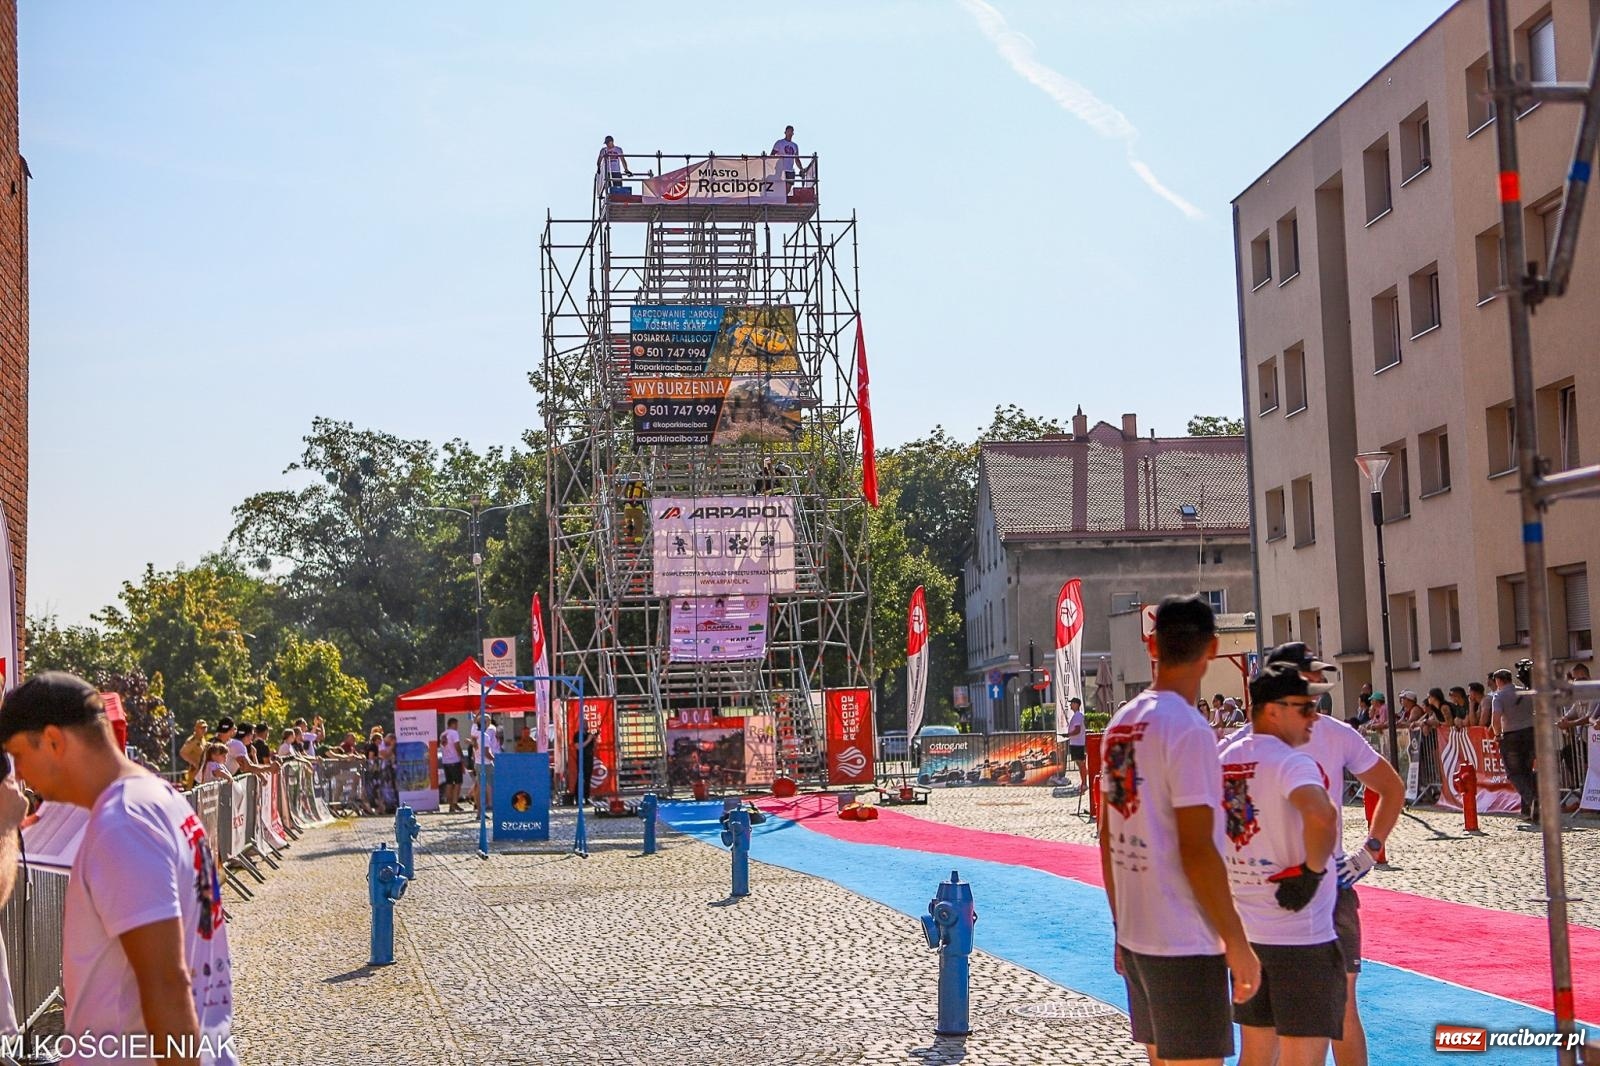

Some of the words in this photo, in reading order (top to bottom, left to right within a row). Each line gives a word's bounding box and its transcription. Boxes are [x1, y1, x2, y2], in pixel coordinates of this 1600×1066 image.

[698, 169, 738, 178] MIASTO
[698, 178, 774, 192] Racibórz
[632, 334, 670, 342] KOSIARKA
[646, 348, 664, 358] 501
[668, 348, 686, 358] 747
[688, 348, 706, 358] 994
[634, 363, 702, 372] koparkiraciborz.pl
[634, 380, 725, 395] WYBURZENIA
[650, 405, 668, 416] 501
[672, 406, 693, 416] 747
[696, 405, 716, 415] 994
[688, 506, 790, 519] ARPAPOL
[930, 741, 968, 751] ostrog.net
[501, 822, 542, 831] SZCZECIN
